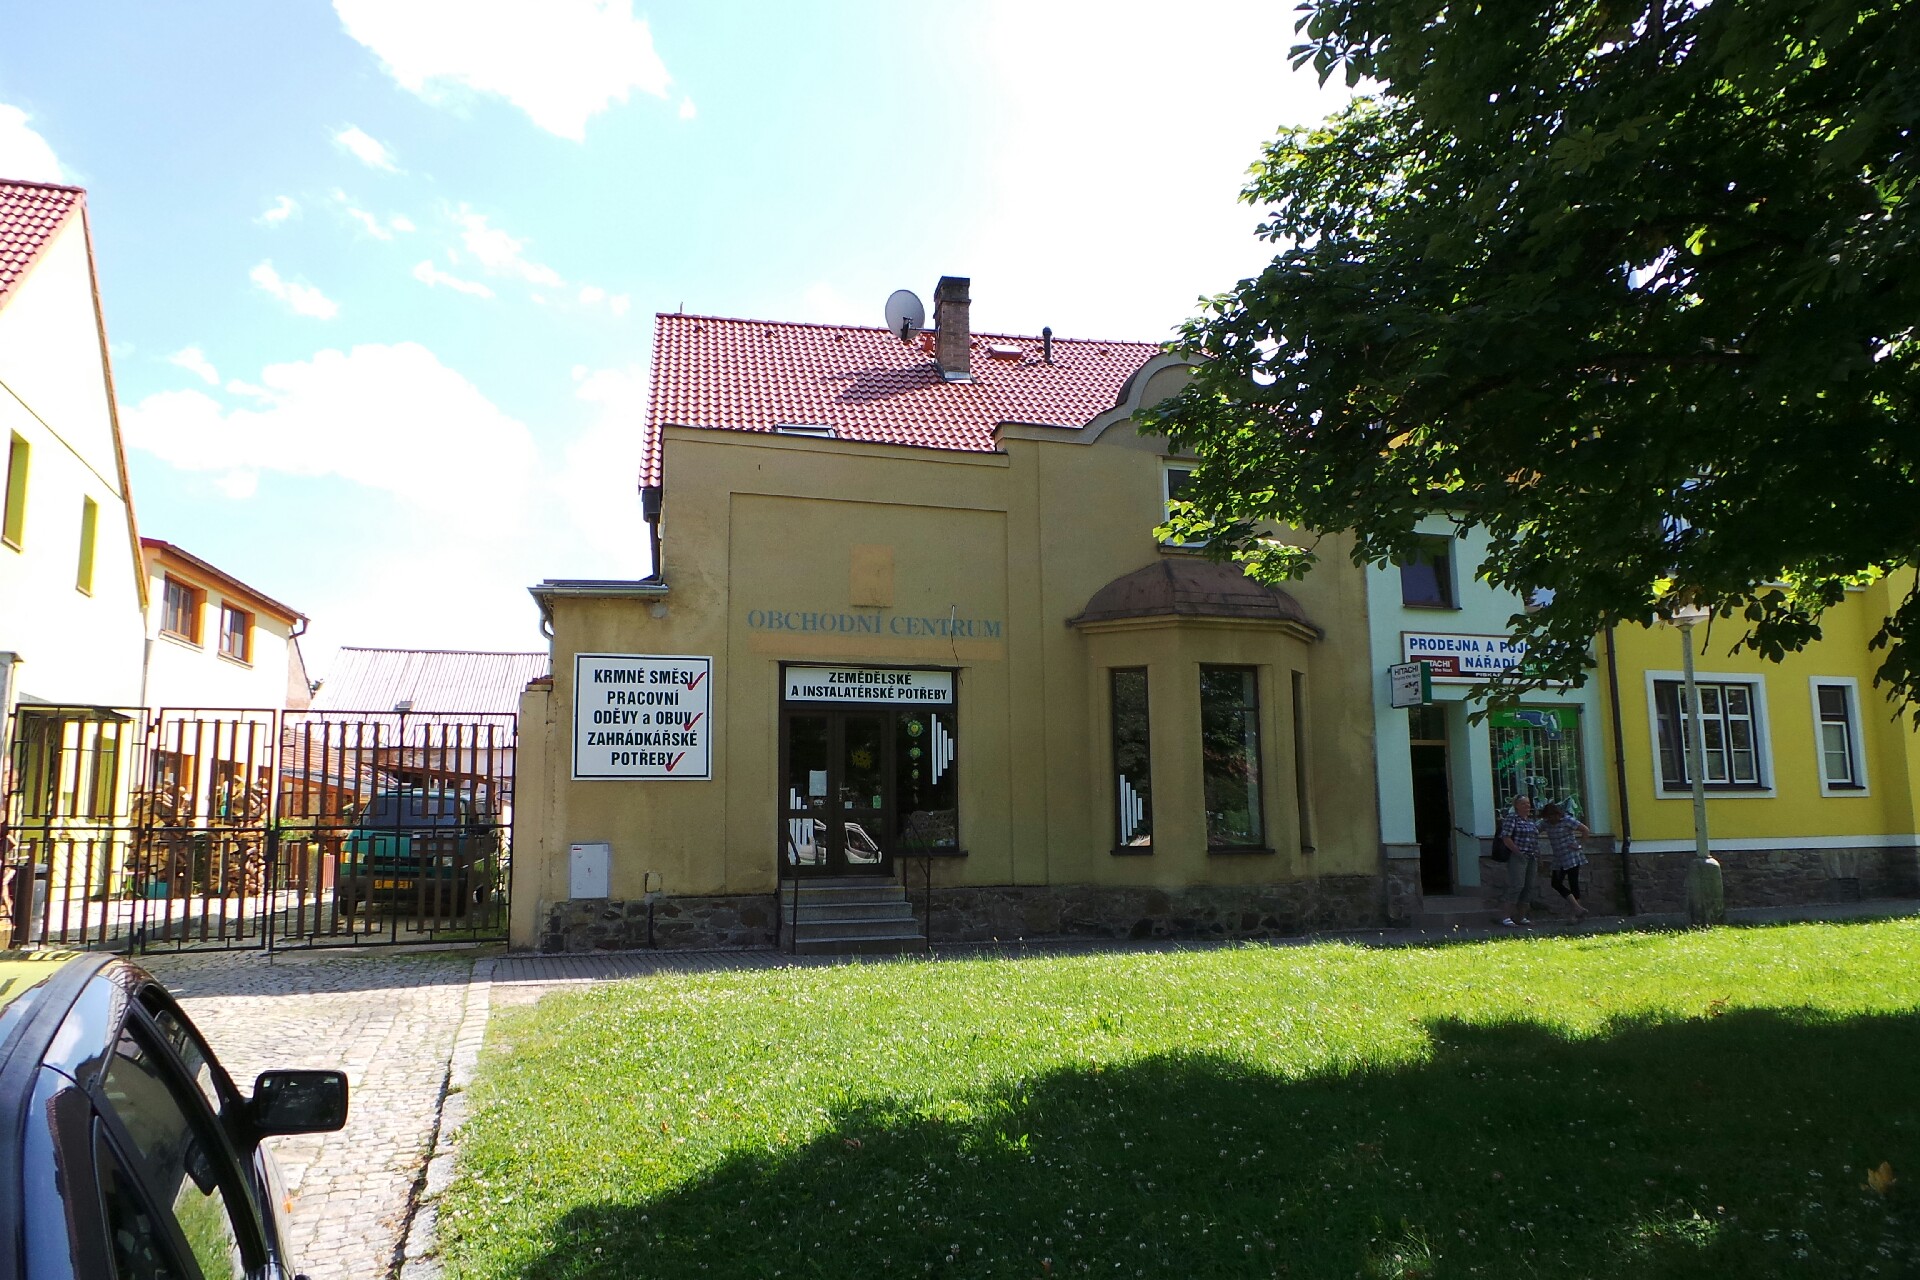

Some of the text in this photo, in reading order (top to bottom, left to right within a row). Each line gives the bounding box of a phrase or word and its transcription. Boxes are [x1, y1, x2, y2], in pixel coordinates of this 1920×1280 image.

[748, 609, 1001, 638] OBCHODNÍ CENTRUM
[1410, 638, 1479, 652] PRODEJNA
[1487, 640, 1495, 652] A
[1465, 655, 1515, 669] NÁŘADÍ
[594, 667, 693, 685] KRMNÉ SMĚSI
[828, 670, 912, 685] ZEMĚDĚLSKÉ
[1394, 665, 1419, 676] HITACHI
[607, 690, 679, 706] PRACOVNÍ
[791, 685, 947, 700] A INSTALATÉRSKÉ POTŘEBY
[593, 708, 692, 725] ODĚVY a OBUV
[587, 729, 698, 747] ZAHRÁDKÁŘSKÉ
[611, 749, 674, 766] POTŘEBY
